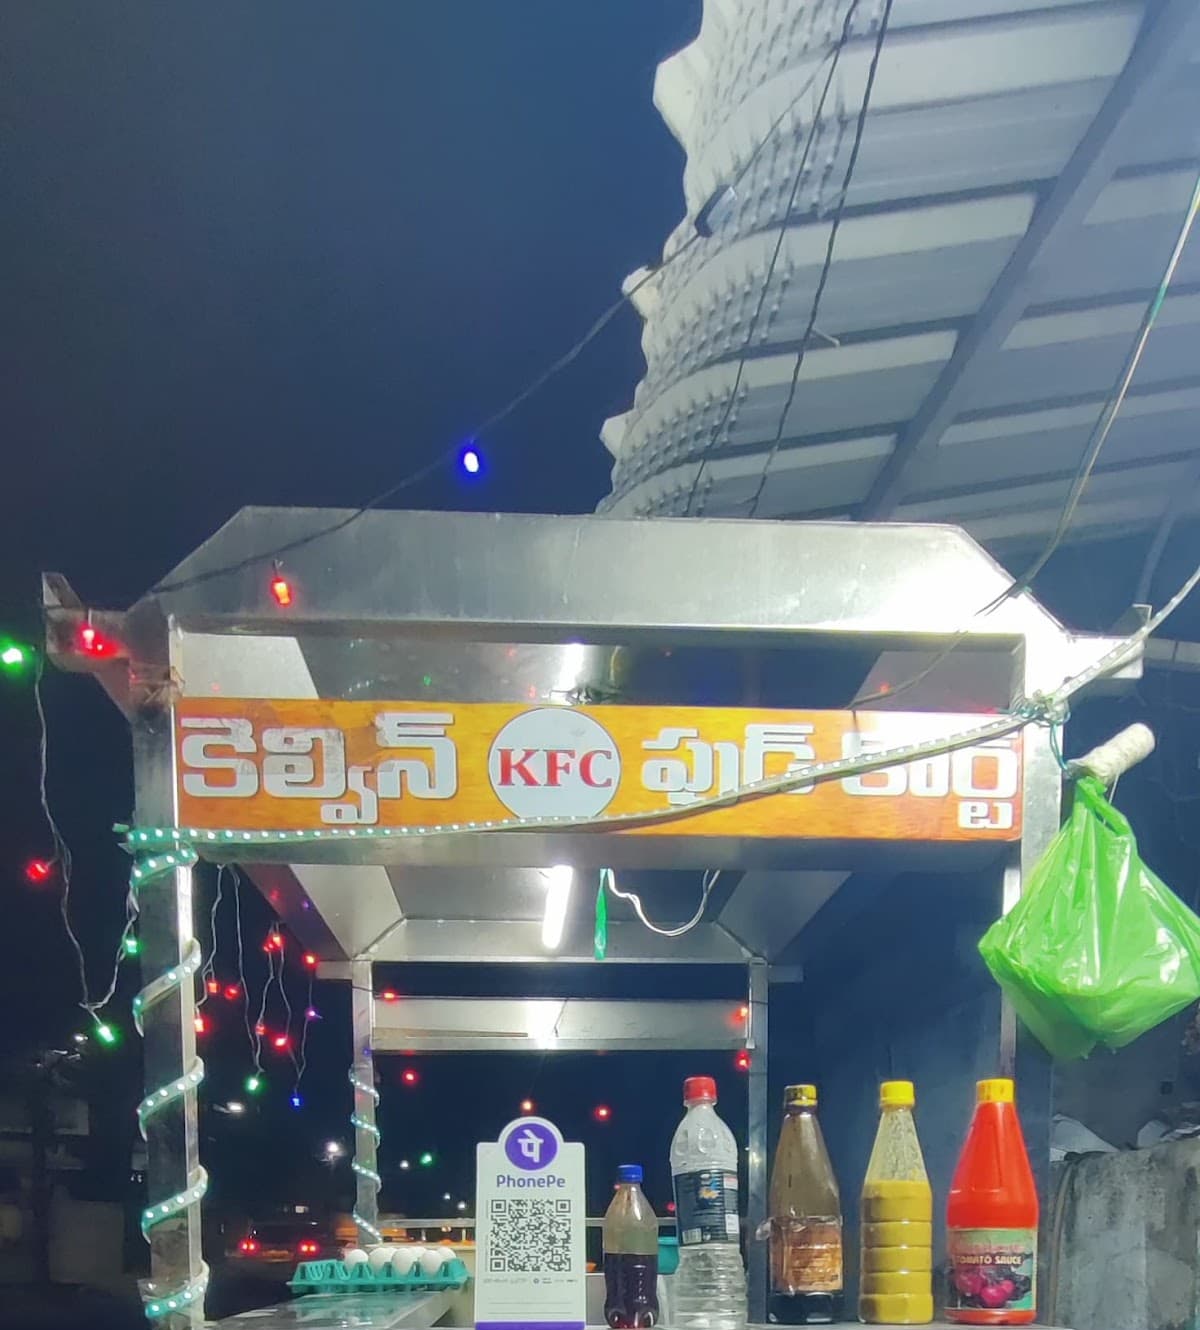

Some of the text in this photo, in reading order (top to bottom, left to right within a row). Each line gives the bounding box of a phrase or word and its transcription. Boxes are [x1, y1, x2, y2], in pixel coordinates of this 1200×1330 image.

[497, 748, 613, 788] KFC
[496, 1174, 566, 1188] PhonePe
[994, 1254, 1022, 1265] SAUCE
